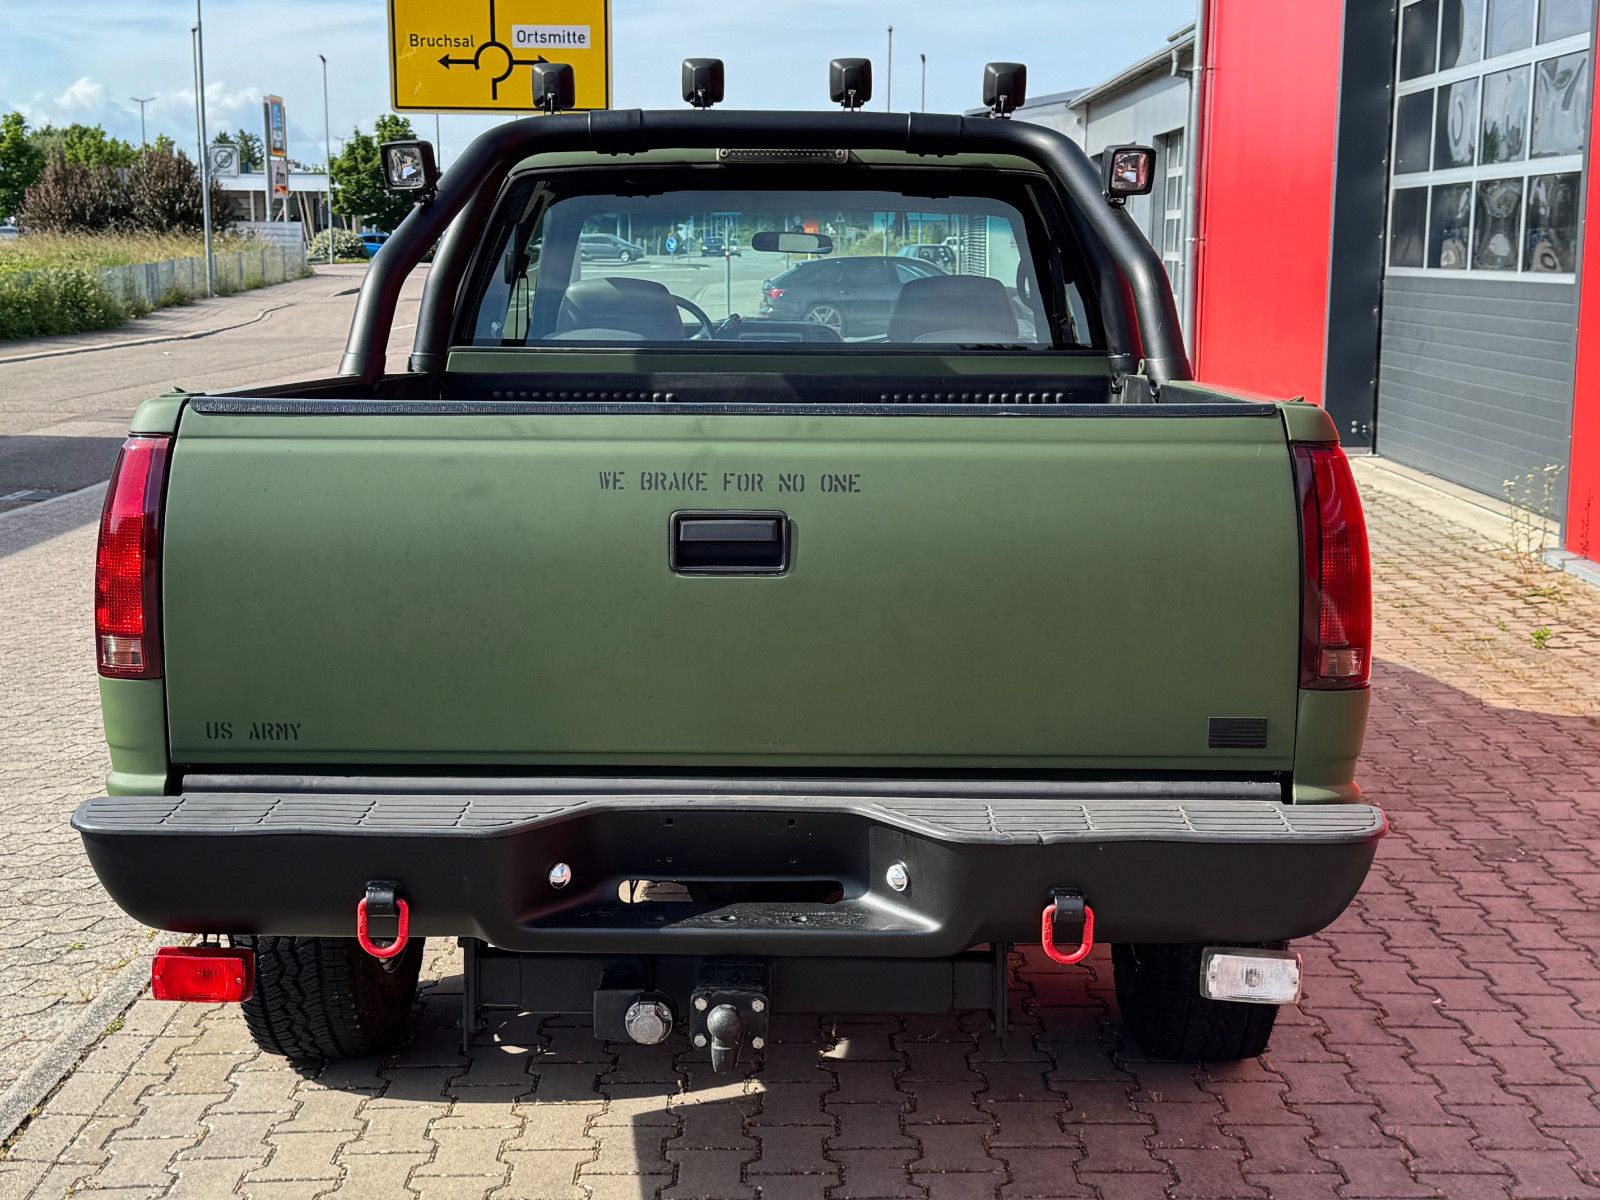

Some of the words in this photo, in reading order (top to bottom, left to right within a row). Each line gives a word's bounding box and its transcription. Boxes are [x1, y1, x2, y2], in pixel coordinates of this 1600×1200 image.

[409, 33, 475, 48] Bruchsal
[516, 29, 586, 44] Ortsmitte
[599, 471, 625, 490] WE
[640, 471, 708, 491] BRAKE
[723, 472, 764, 492] FOR
[778, 473, 805, 492] NO
[820, 474, 861, 492] ONE
[206, 721, 233, 740] US
[249, 722, 301, 741] ARMY
